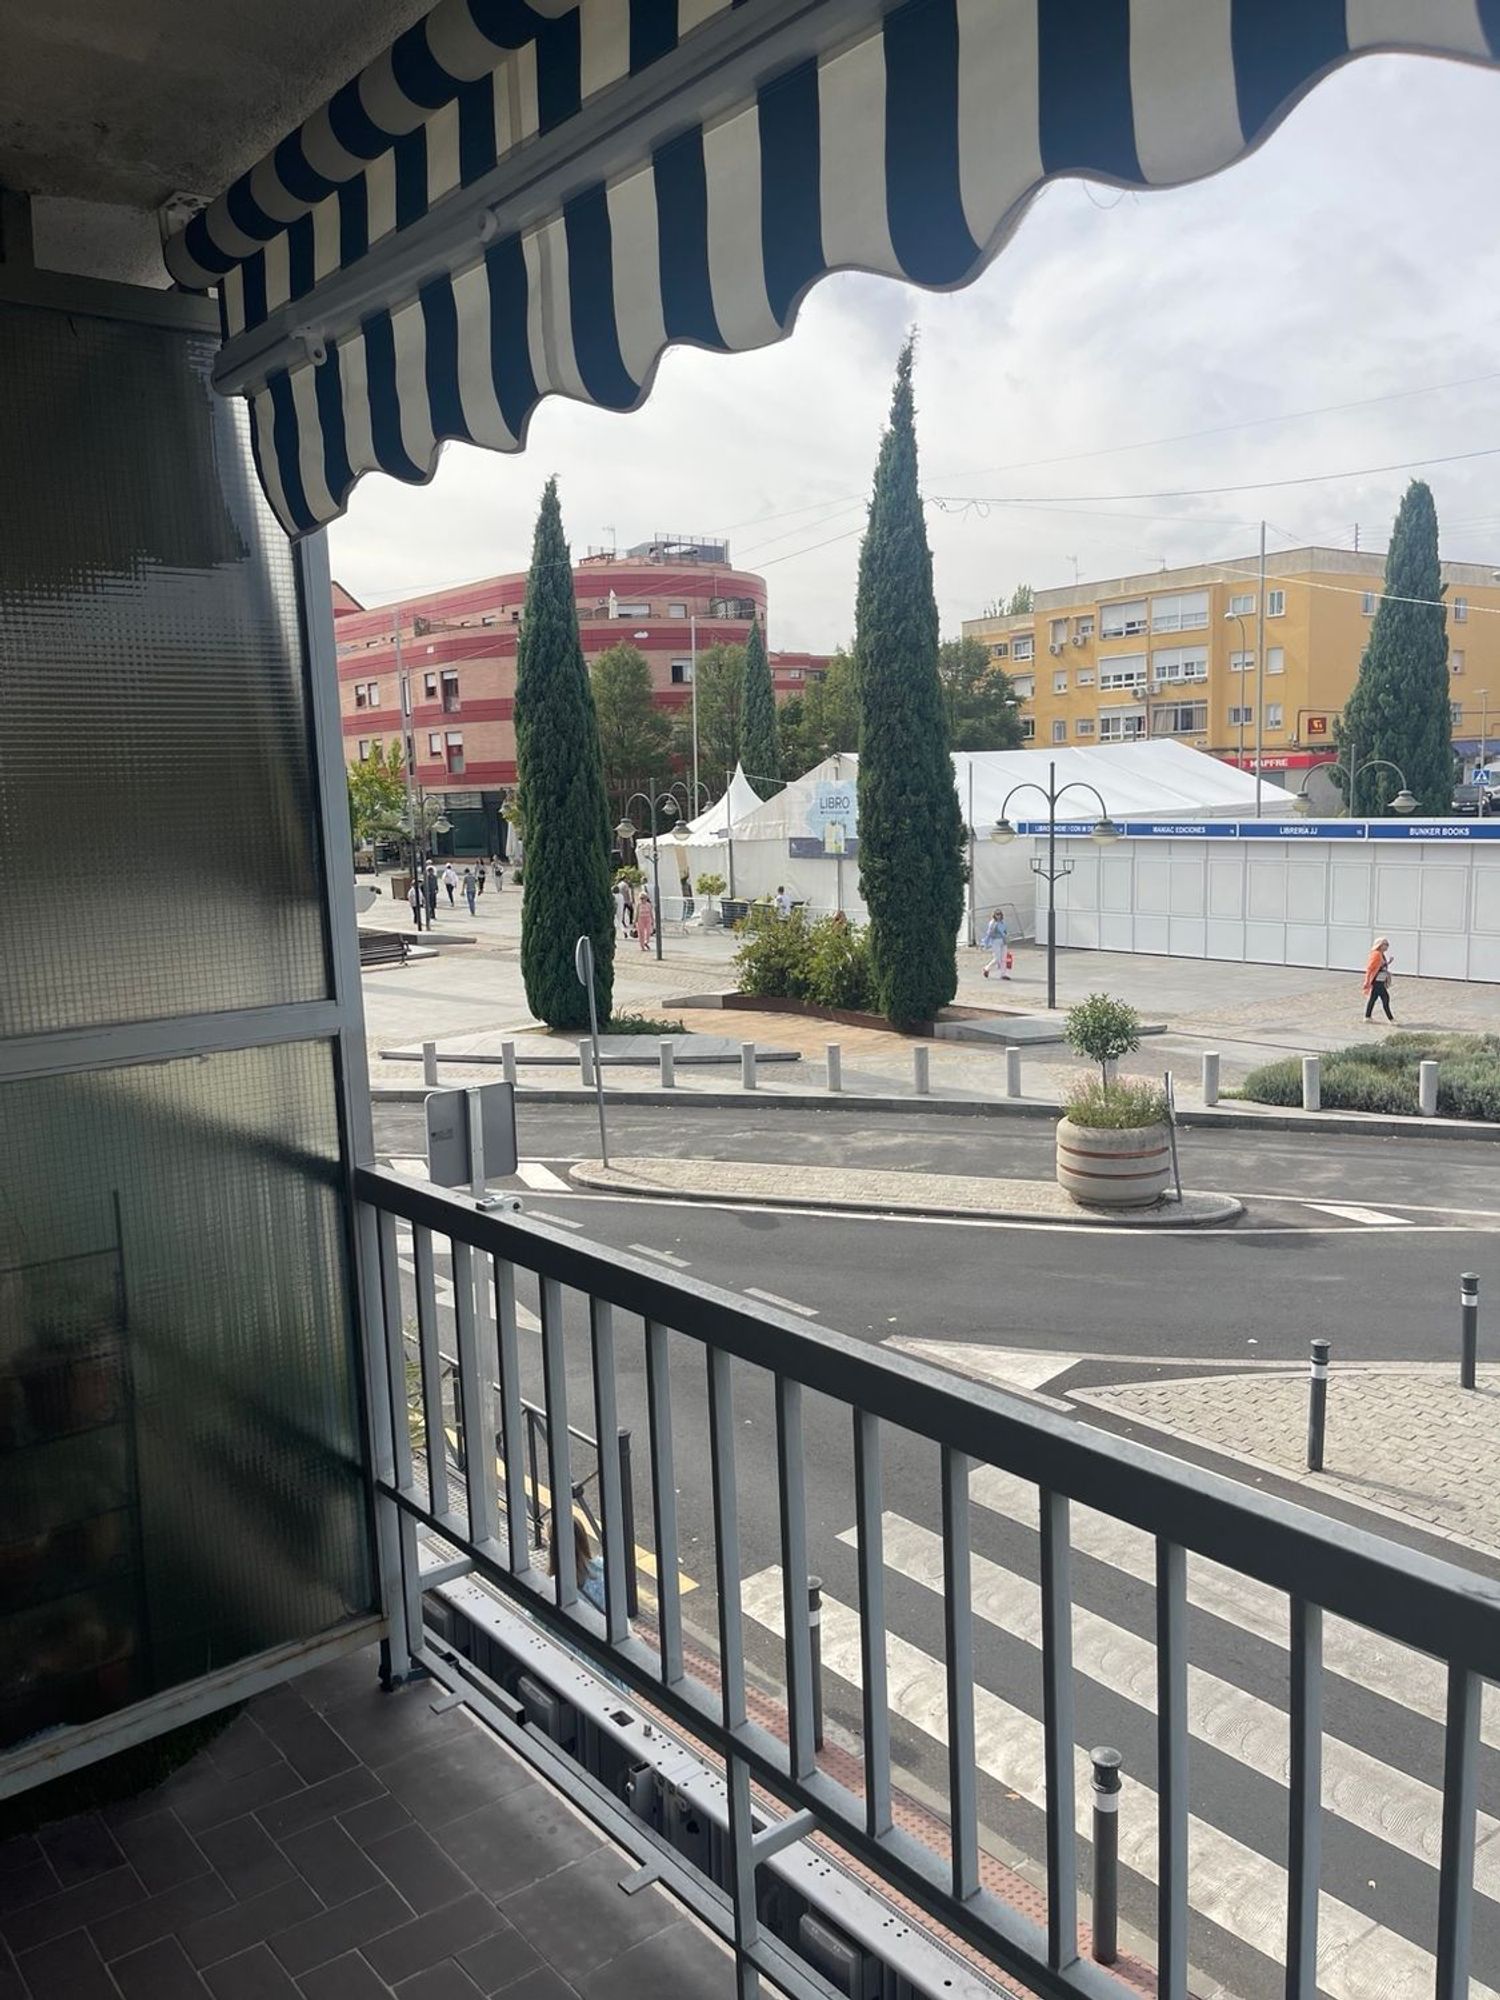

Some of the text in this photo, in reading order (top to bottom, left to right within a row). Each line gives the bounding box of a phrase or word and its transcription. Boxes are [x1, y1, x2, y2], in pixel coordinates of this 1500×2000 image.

[820, 796, 851, 809] LIBRO
[1409, 827, 1470, 836] BUNKER BOOKS
